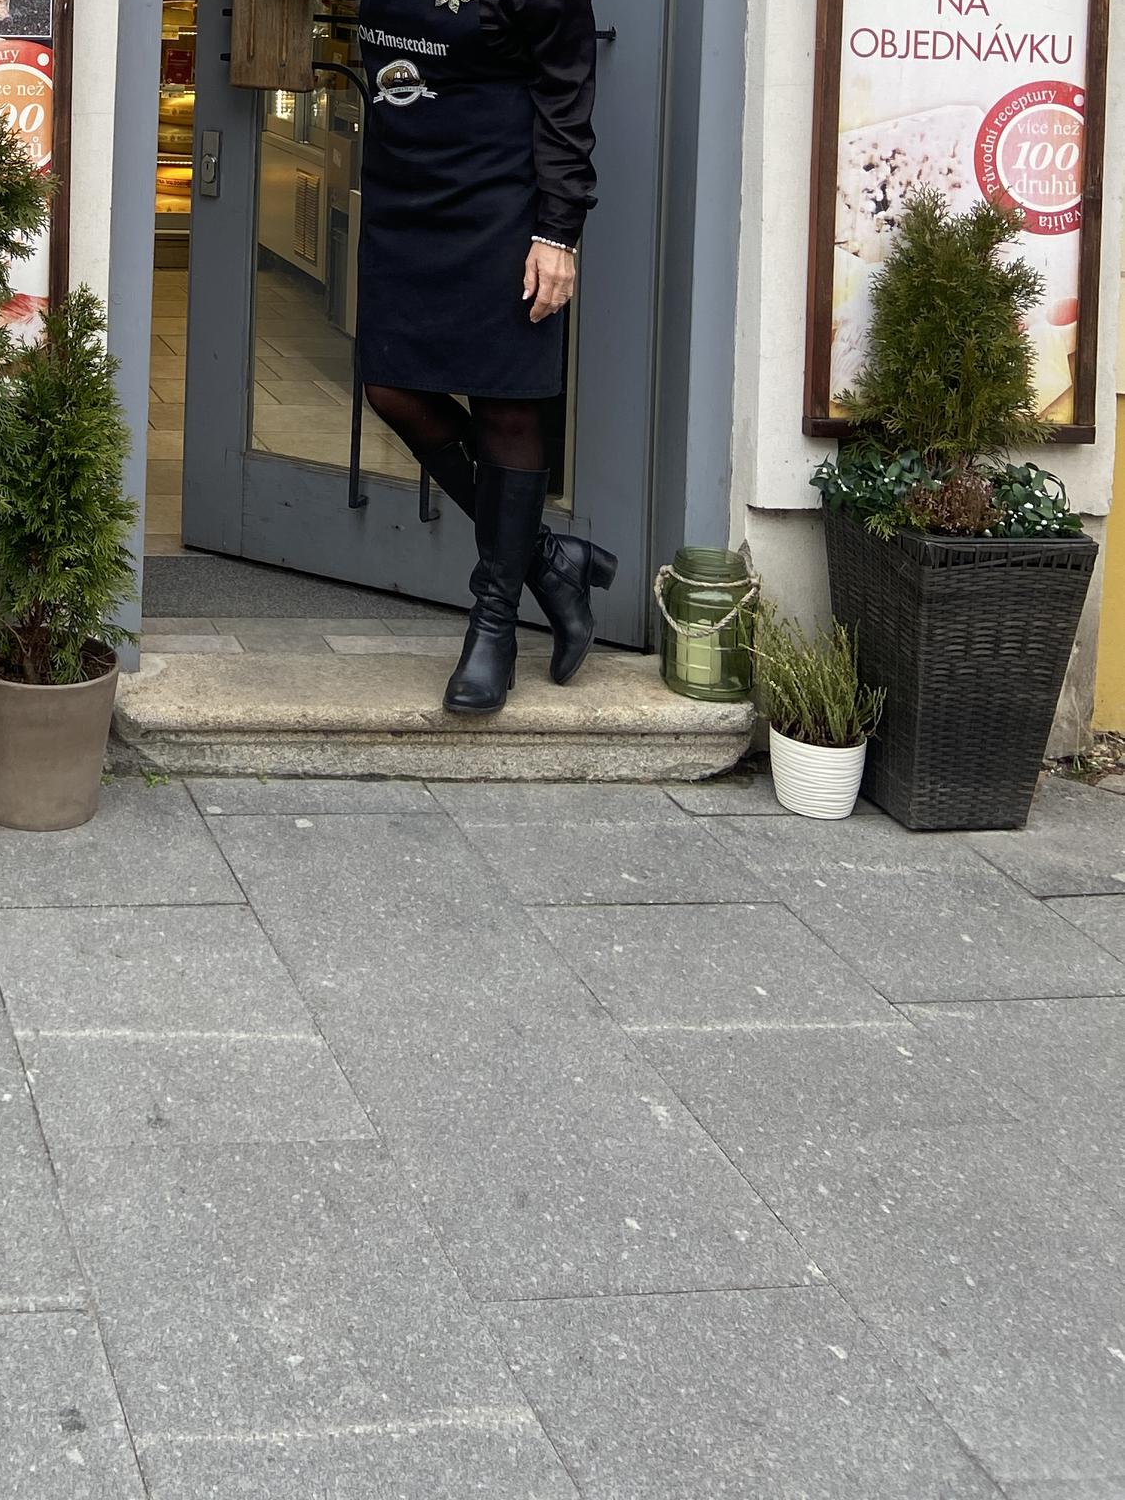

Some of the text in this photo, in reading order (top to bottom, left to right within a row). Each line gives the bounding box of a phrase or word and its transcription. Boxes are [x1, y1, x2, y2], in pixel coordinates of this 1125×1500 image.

[358, 24, 448, 57] Old Amsterdam
[850, 24, 1073, 64] OBJEDNÁVKU
[17, 80, 45, 96] než
[980, 90, 1057, 195] Původní receptury
[1017, 119, 1081, 136] více než
[1012, 141, 1080, 171] 100
[1015, 173, 1077, 196] druhů
